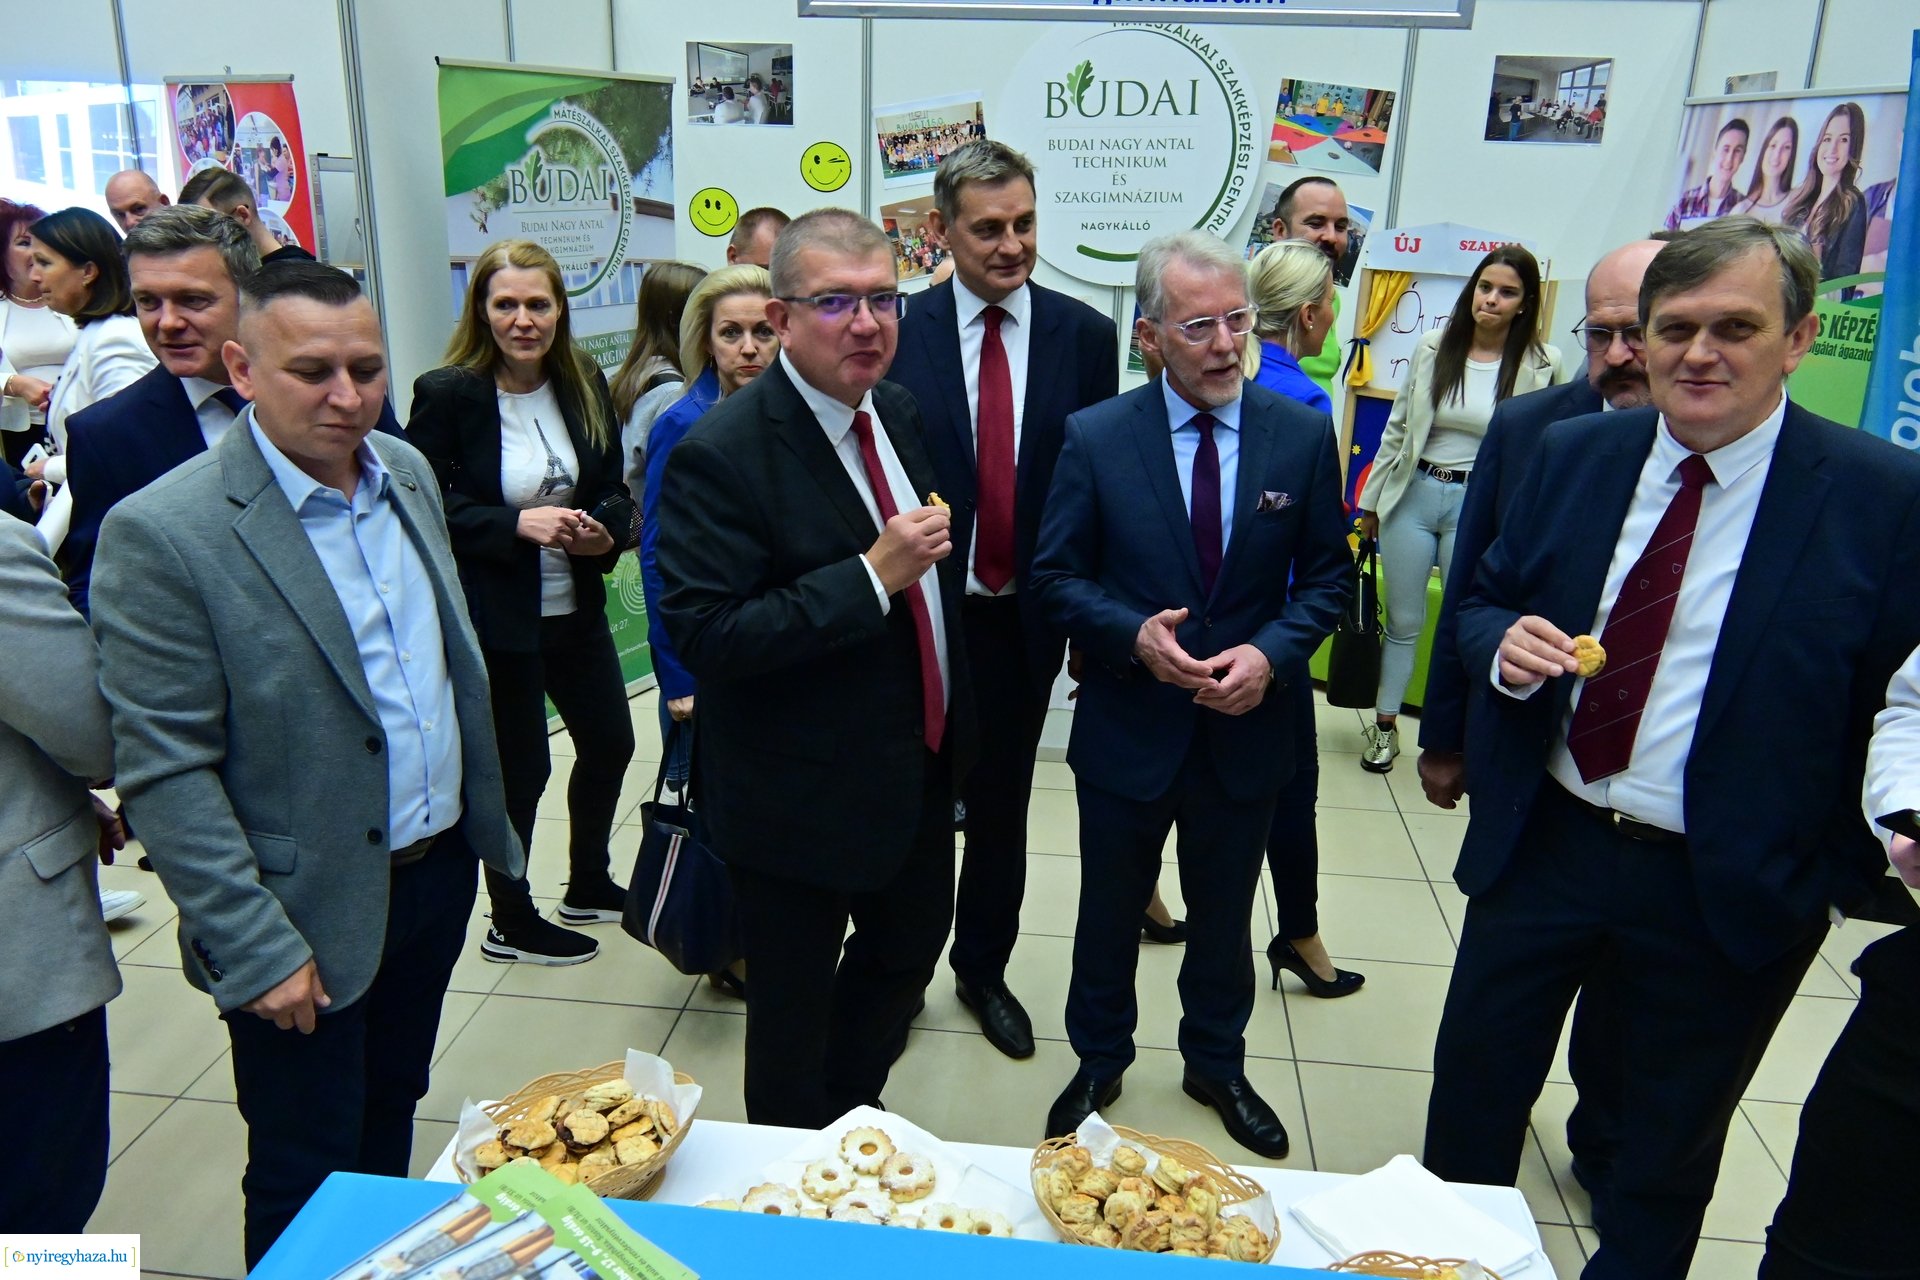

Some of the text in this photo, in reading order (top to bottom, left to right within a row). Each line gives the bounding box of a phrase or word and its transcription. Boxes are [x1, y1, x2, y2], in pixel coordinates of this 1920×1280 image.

[1044, 79, 1200, 118] BUDAI
[1216, 58, 1254, 170] SZAKKÉPZÉSI
[1048, 138, 1195, 151] BUDAI NAGY ANTAL
[1072, 156, 1167, 169] TECHNIKUM
[510, 169, 609, 204] BUDAI
[1112, 171, 1127, 186] ÉS
[553, 106, 633, 281] MÁTÉSZALKAI SZAKKÉPZÉSI CENTRUM
[1054, 188, 1183, 204] SZAKGIMNÁZIUM
[1207, 174, 1245, 232] CENTRU
[521, 219, 605, 233] BUDAI NAGY ANTAL
[1081, 220, 1151, 231] NAGYKÁLLÓ
[1394, 232, 1422, 253] ÚJ
[1828, 310, 1877, 344] KÉPZÉ
[588, 337, 609, 351] NAGY
[610, 333, 630, 346] ANTAL
